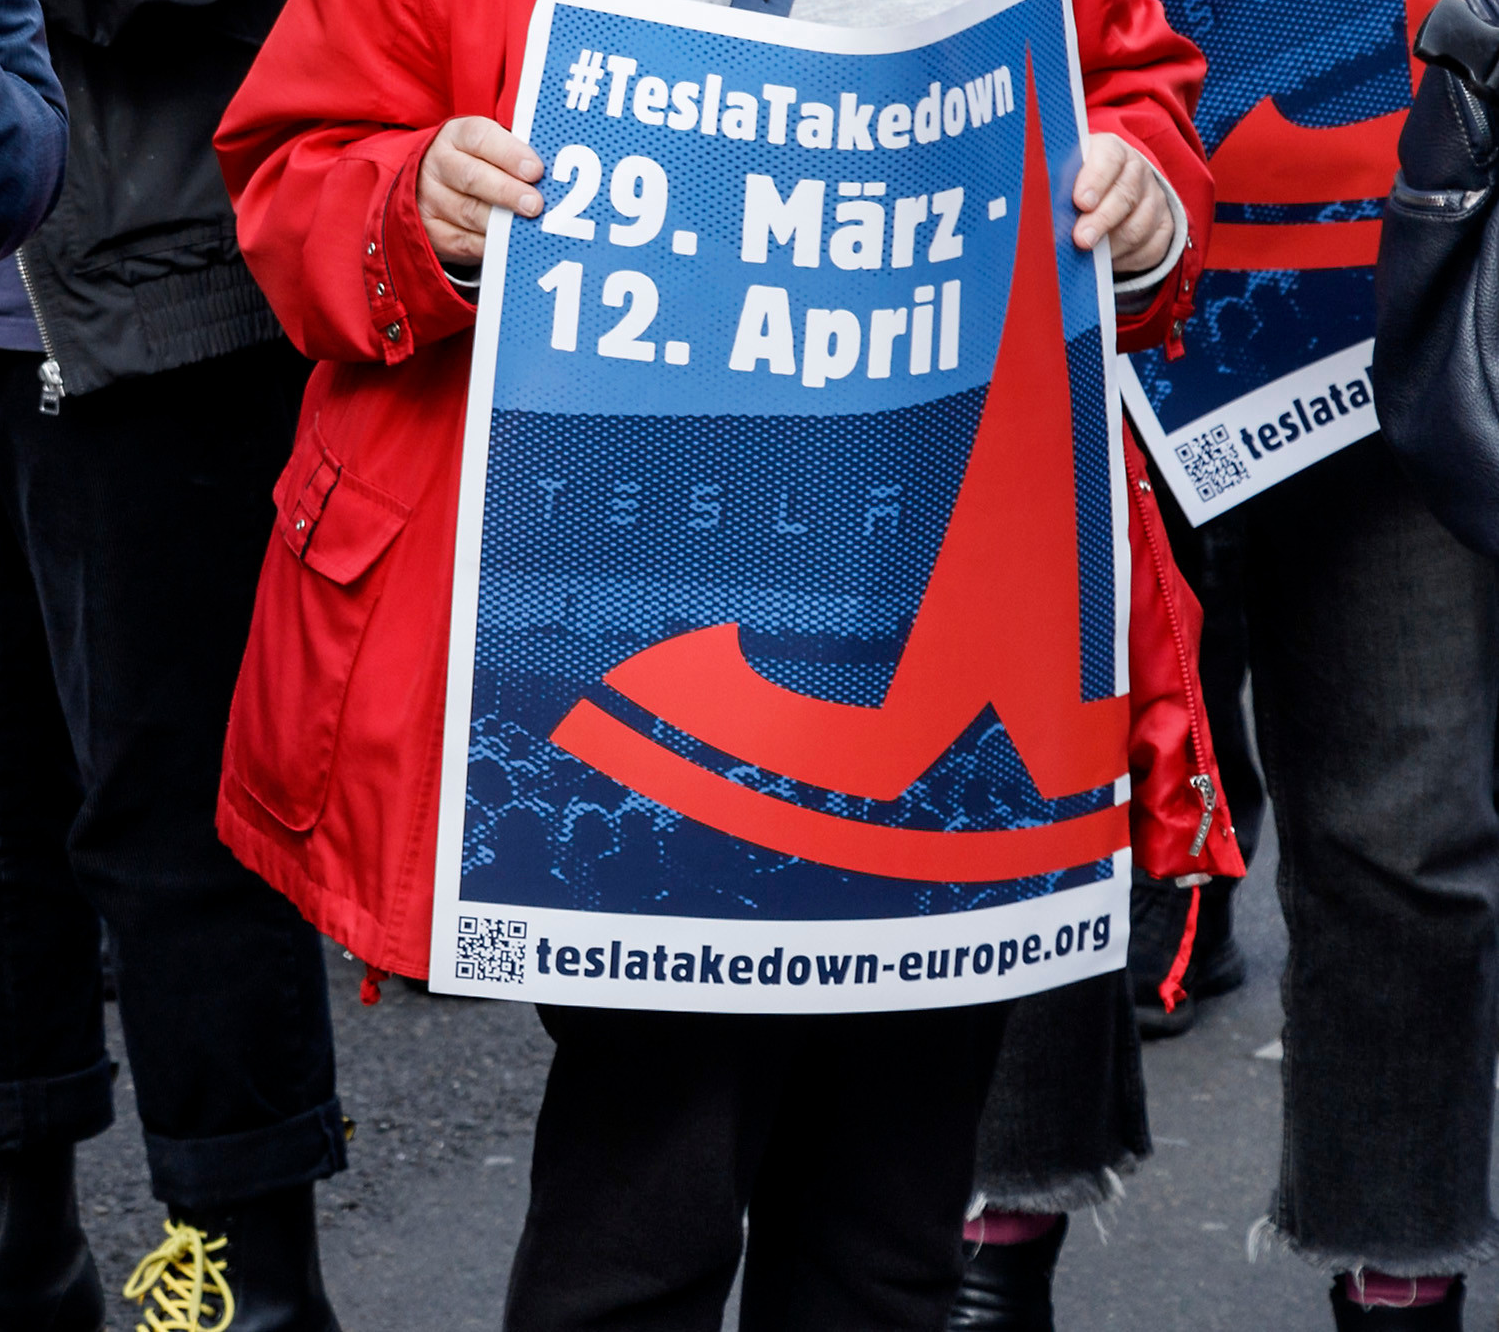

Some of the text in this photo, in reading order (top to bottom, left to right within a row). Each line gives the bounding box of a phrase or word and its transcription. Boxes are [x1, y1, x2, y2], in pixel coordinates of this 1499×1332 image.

[564, 48, 1015, 152] #TeslaTakedown
[540, 143, 698, 257] 29.
[740, 173, 965, 271] März
[536, 259, 962, 389] 12. April
[535, 912, 1112, 987] teslatakedown-europe.org
